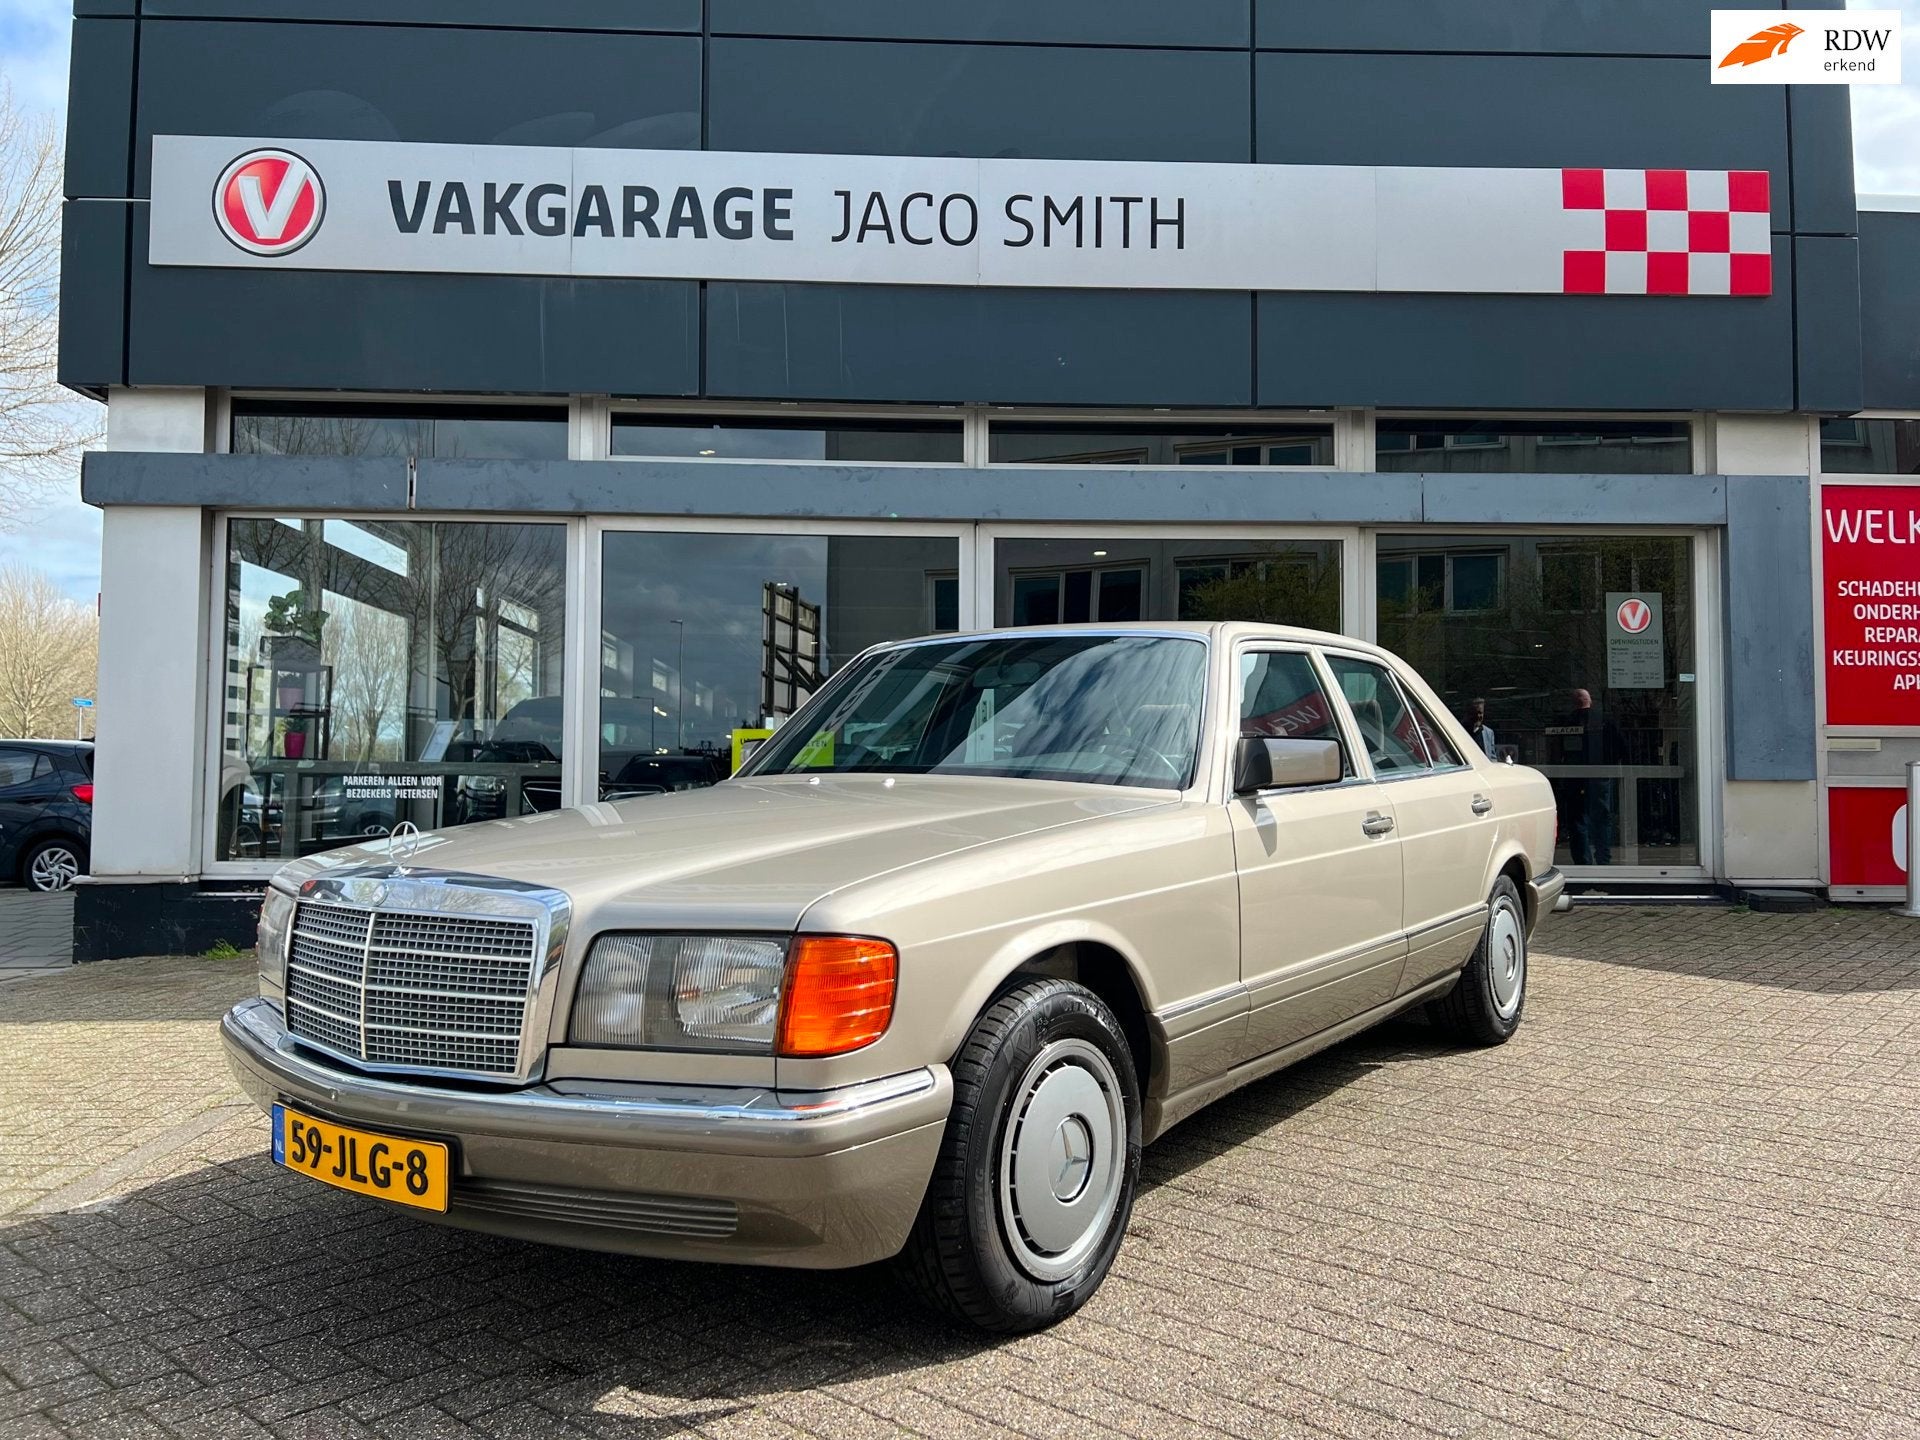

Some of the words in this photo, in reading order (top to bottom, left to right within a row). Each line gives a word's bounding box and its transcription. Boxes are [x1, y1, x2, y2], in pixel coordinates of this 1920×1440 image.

[388, 179, 794, 241] VAKGARAGE
[831, 190, 978, 246] JACO
[1003, 194, 1185, 250] SMITH
[1838, 580, 1920, 597] SCHADEH
[1865, 626, 1920, 643] REPAR
[1833, 649, 1920, 667] KEURINGS
[343, 775, 385, 786] PARKEREN
[388, 776, 418, 786] ALLEEN
[421, 776, 442, 786] VOOR
[346, 788, 391, 799] BEZOEKERS
[395, 788, 438, 799] PIETERSEN
[291, 1119, 429, 1196] 59-JLG-8
